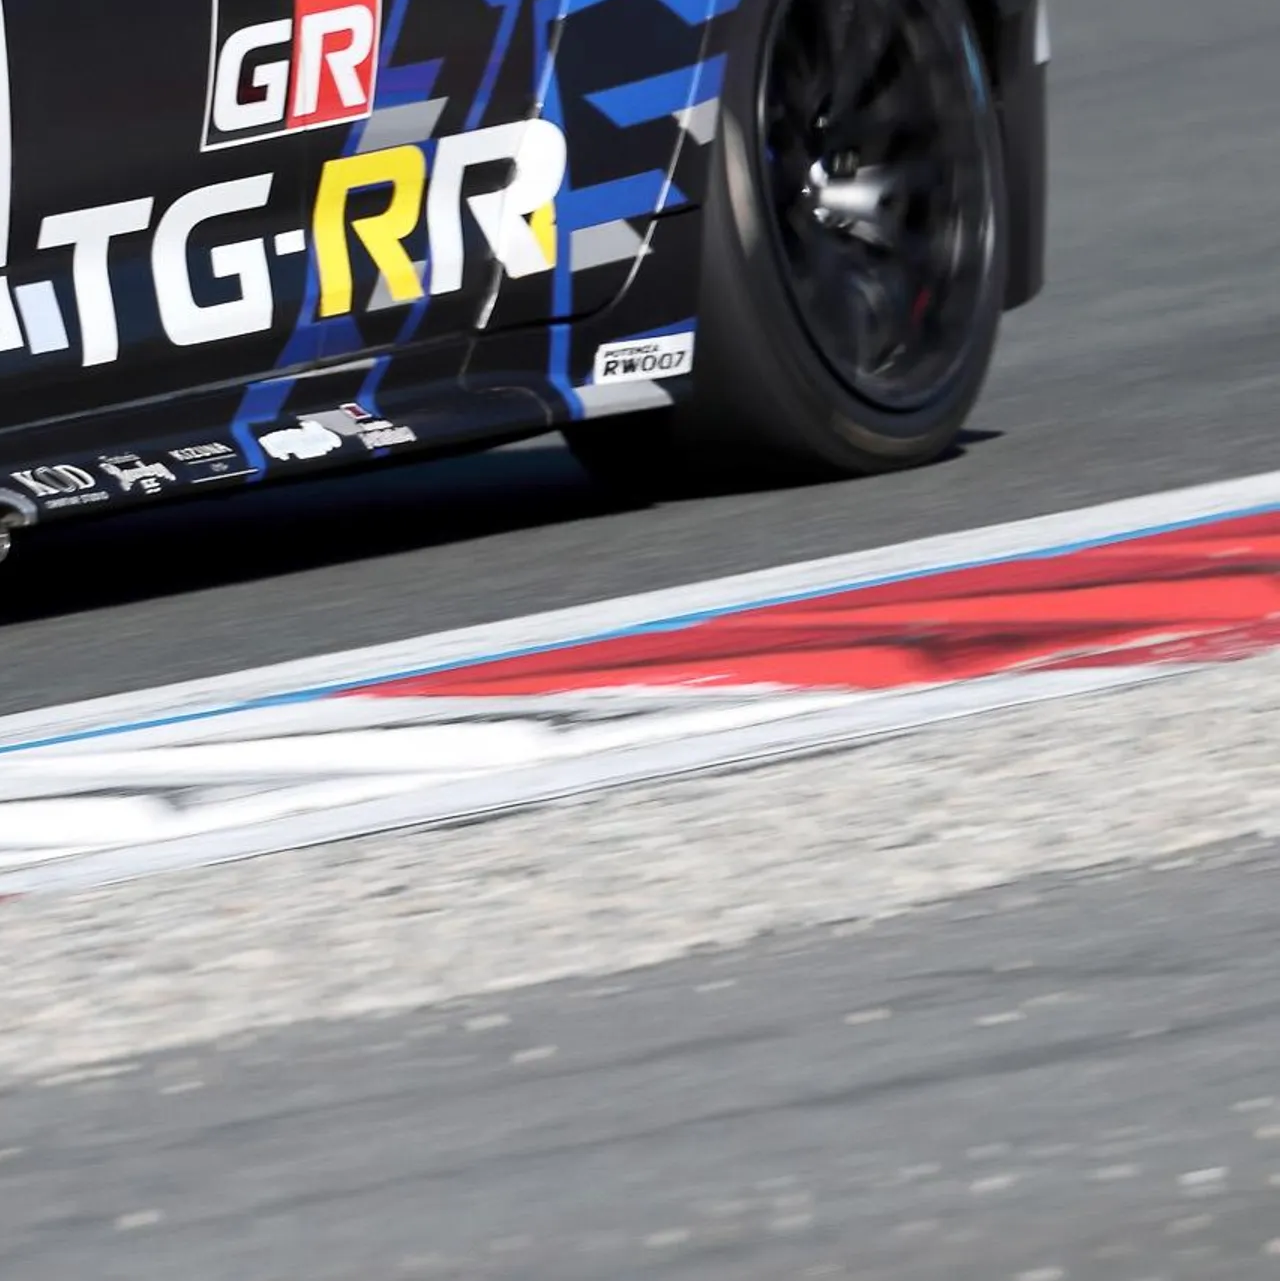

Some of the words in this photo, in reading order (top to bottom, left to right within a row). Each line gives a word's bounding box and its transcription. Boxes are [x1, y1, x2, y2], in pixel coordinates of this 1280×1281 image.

[213, 3, 376, 132] GR
[36, 117, 568, 367] TG-RR
[602, 350, 686, 377] RW007
